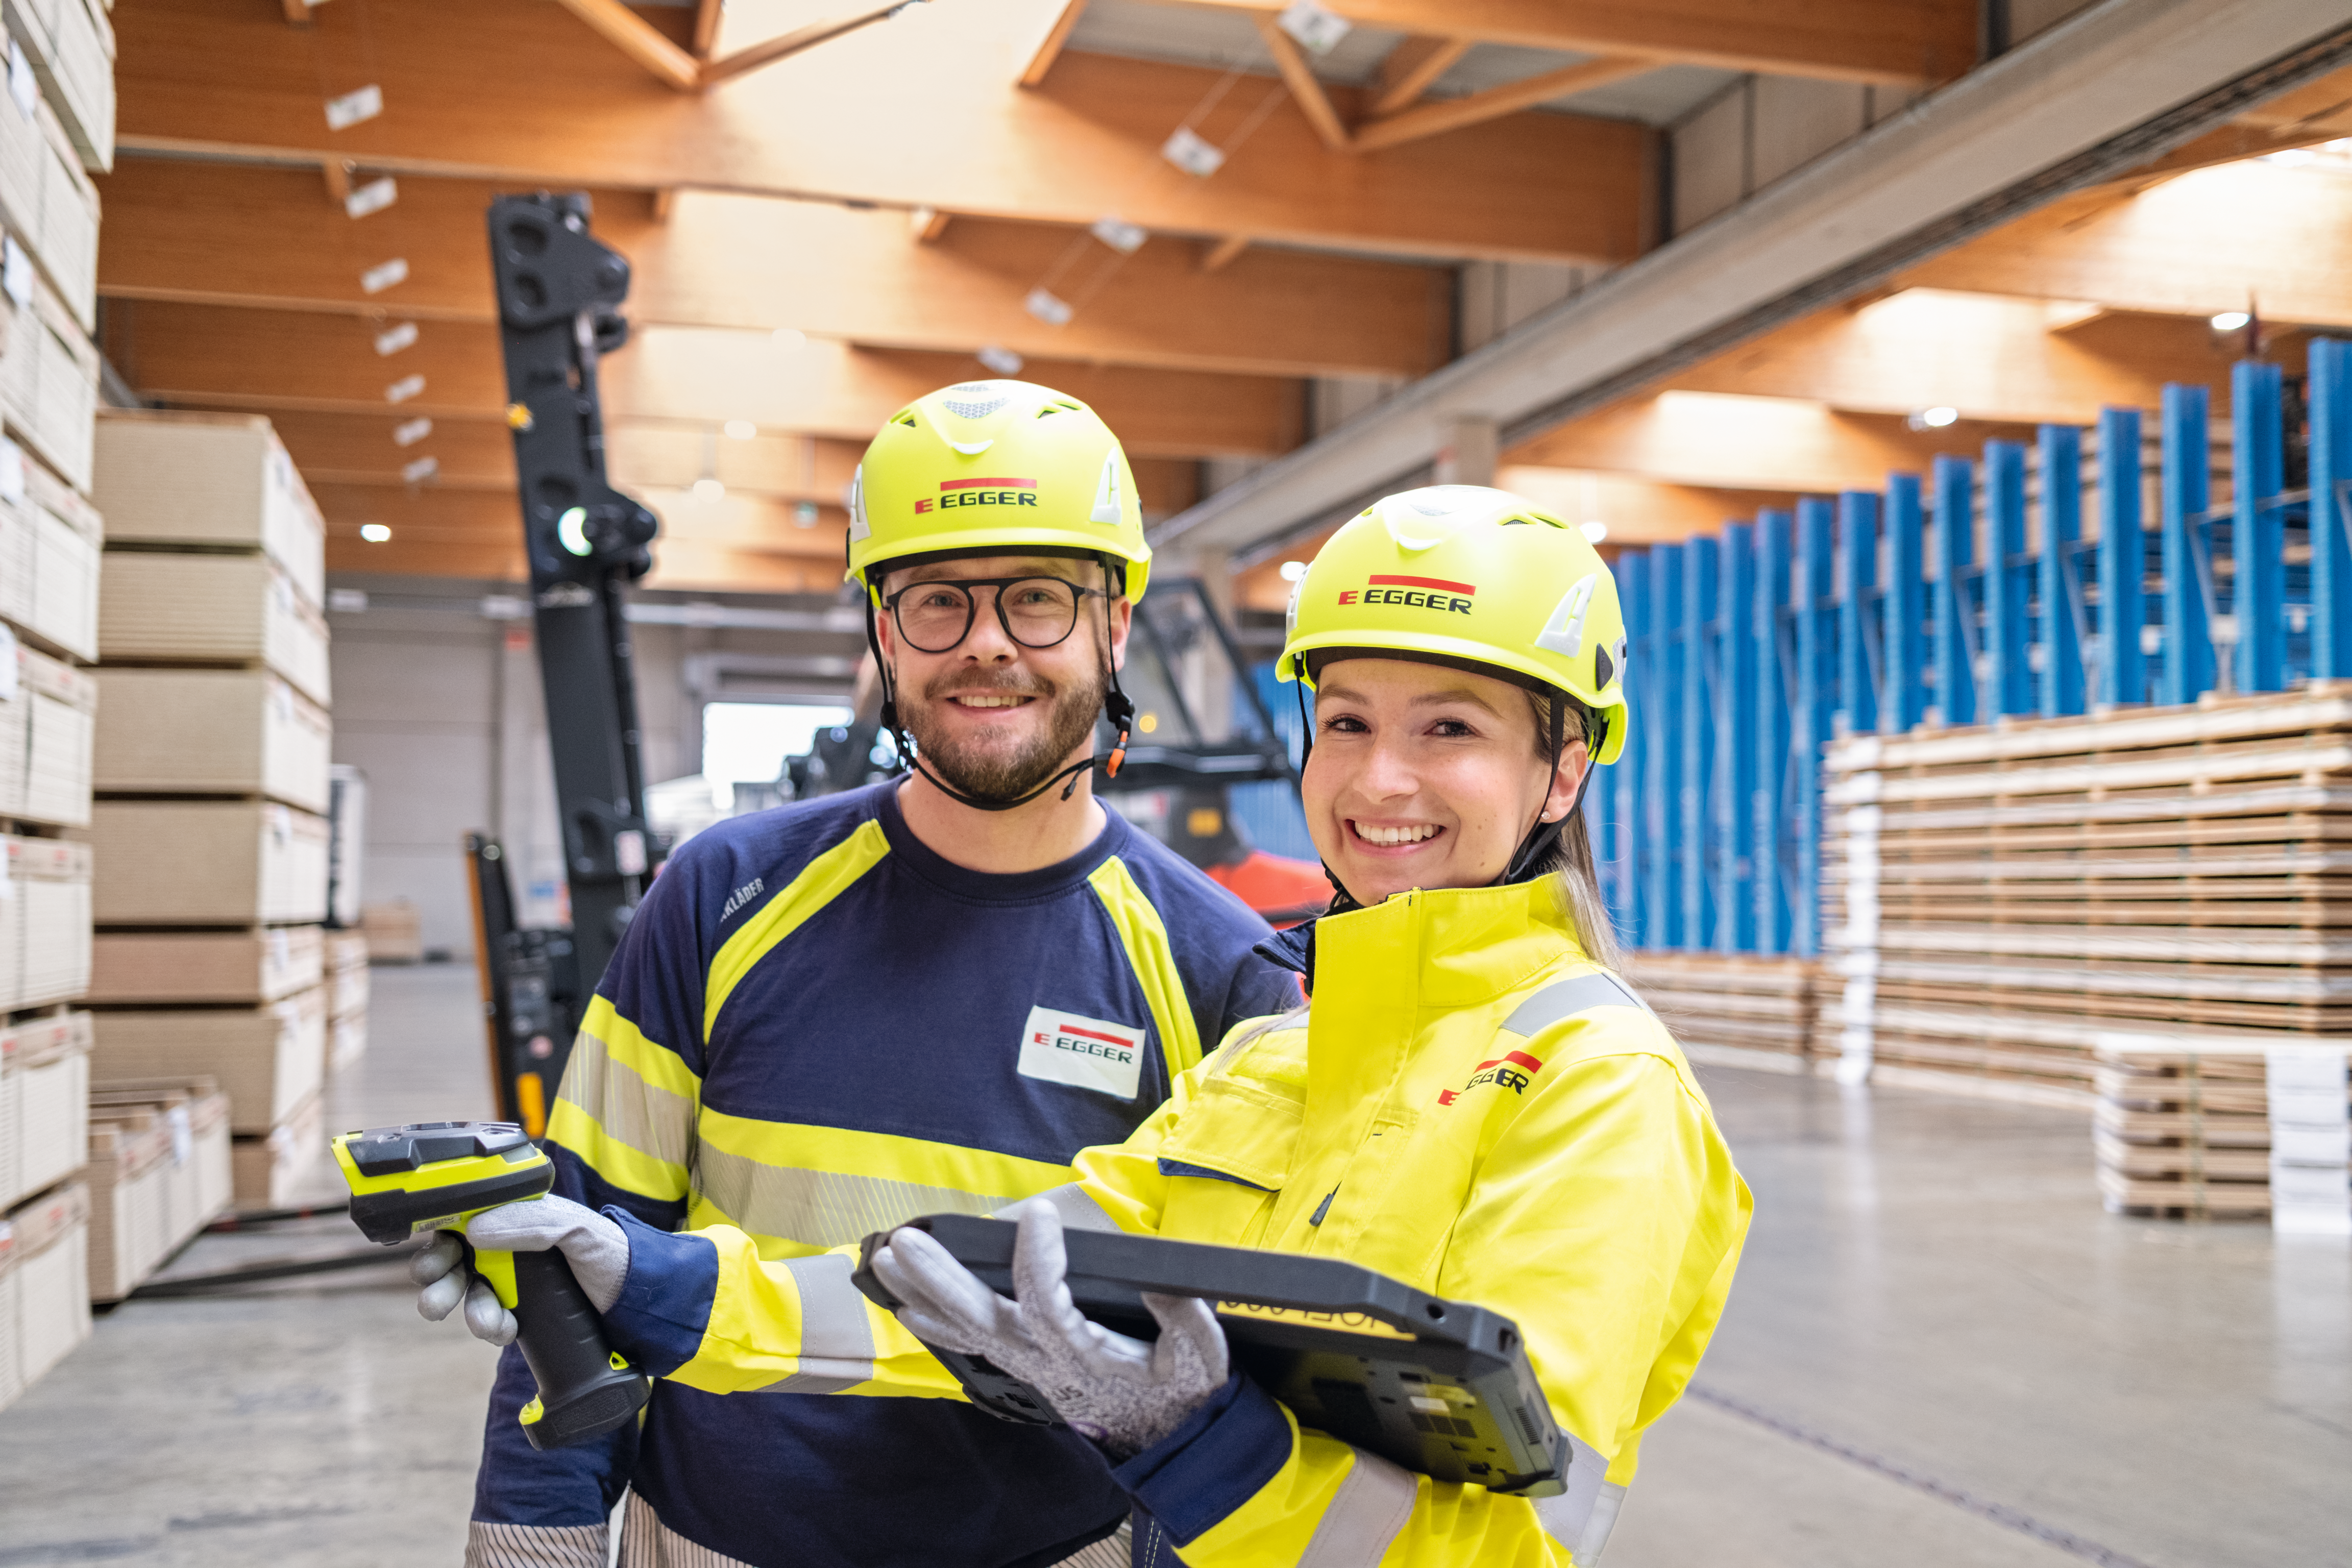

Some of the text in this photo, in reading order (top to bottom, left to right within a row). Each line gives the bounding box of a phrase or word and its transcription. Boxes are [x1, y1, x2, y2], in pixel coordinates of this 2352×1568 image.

[915, 492, 1038, 514] E EGGER
[1338, 590, 1472, 615] E EGGER
[1034, 1032, 1133, 1064] E EGGER
[1437, 1068, 1529, 1106] E GGER
